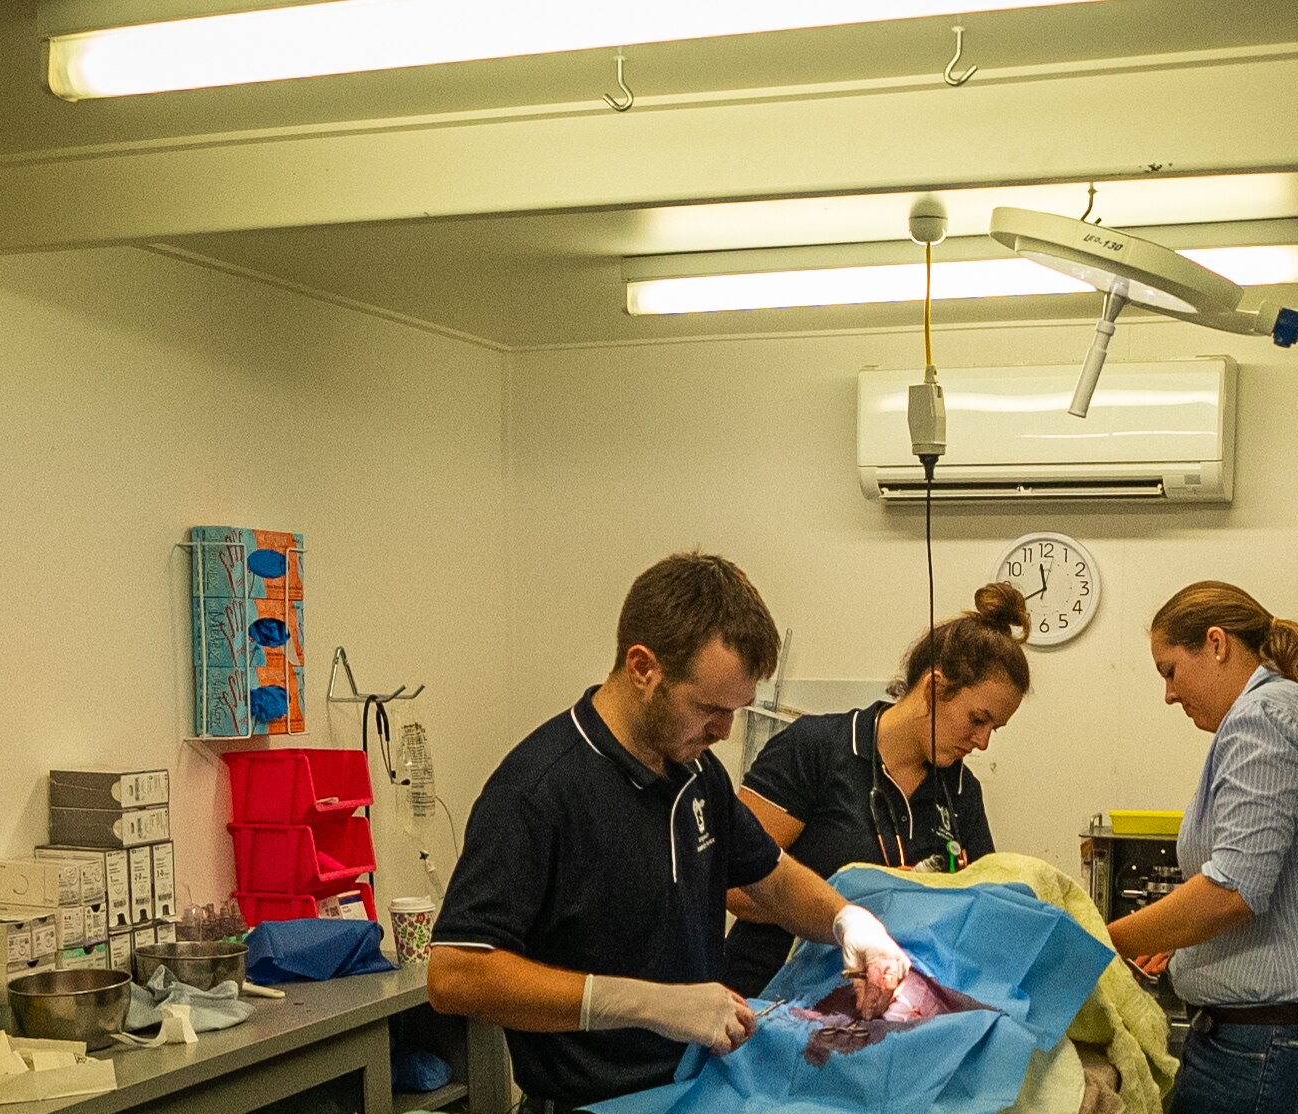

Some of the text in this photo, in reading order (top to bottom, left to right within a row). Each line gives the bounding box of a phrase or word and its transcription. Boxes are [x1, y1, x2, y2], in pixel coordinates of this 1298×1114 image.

[1022, 548, 1033, 563] 11
[1038, 543, 1054, 558] 12
[1063, 548, 1068, 563] 1
[1006, 561, 1022, 577] 10
[1075, 562, 1086, 577] 2
[1079, 581, 1090, 596] 3
[1072, 600, 1083, 615] 4
[1039, 618, 1050, 633] 6
[1058, 614, 1069, 629] 5
